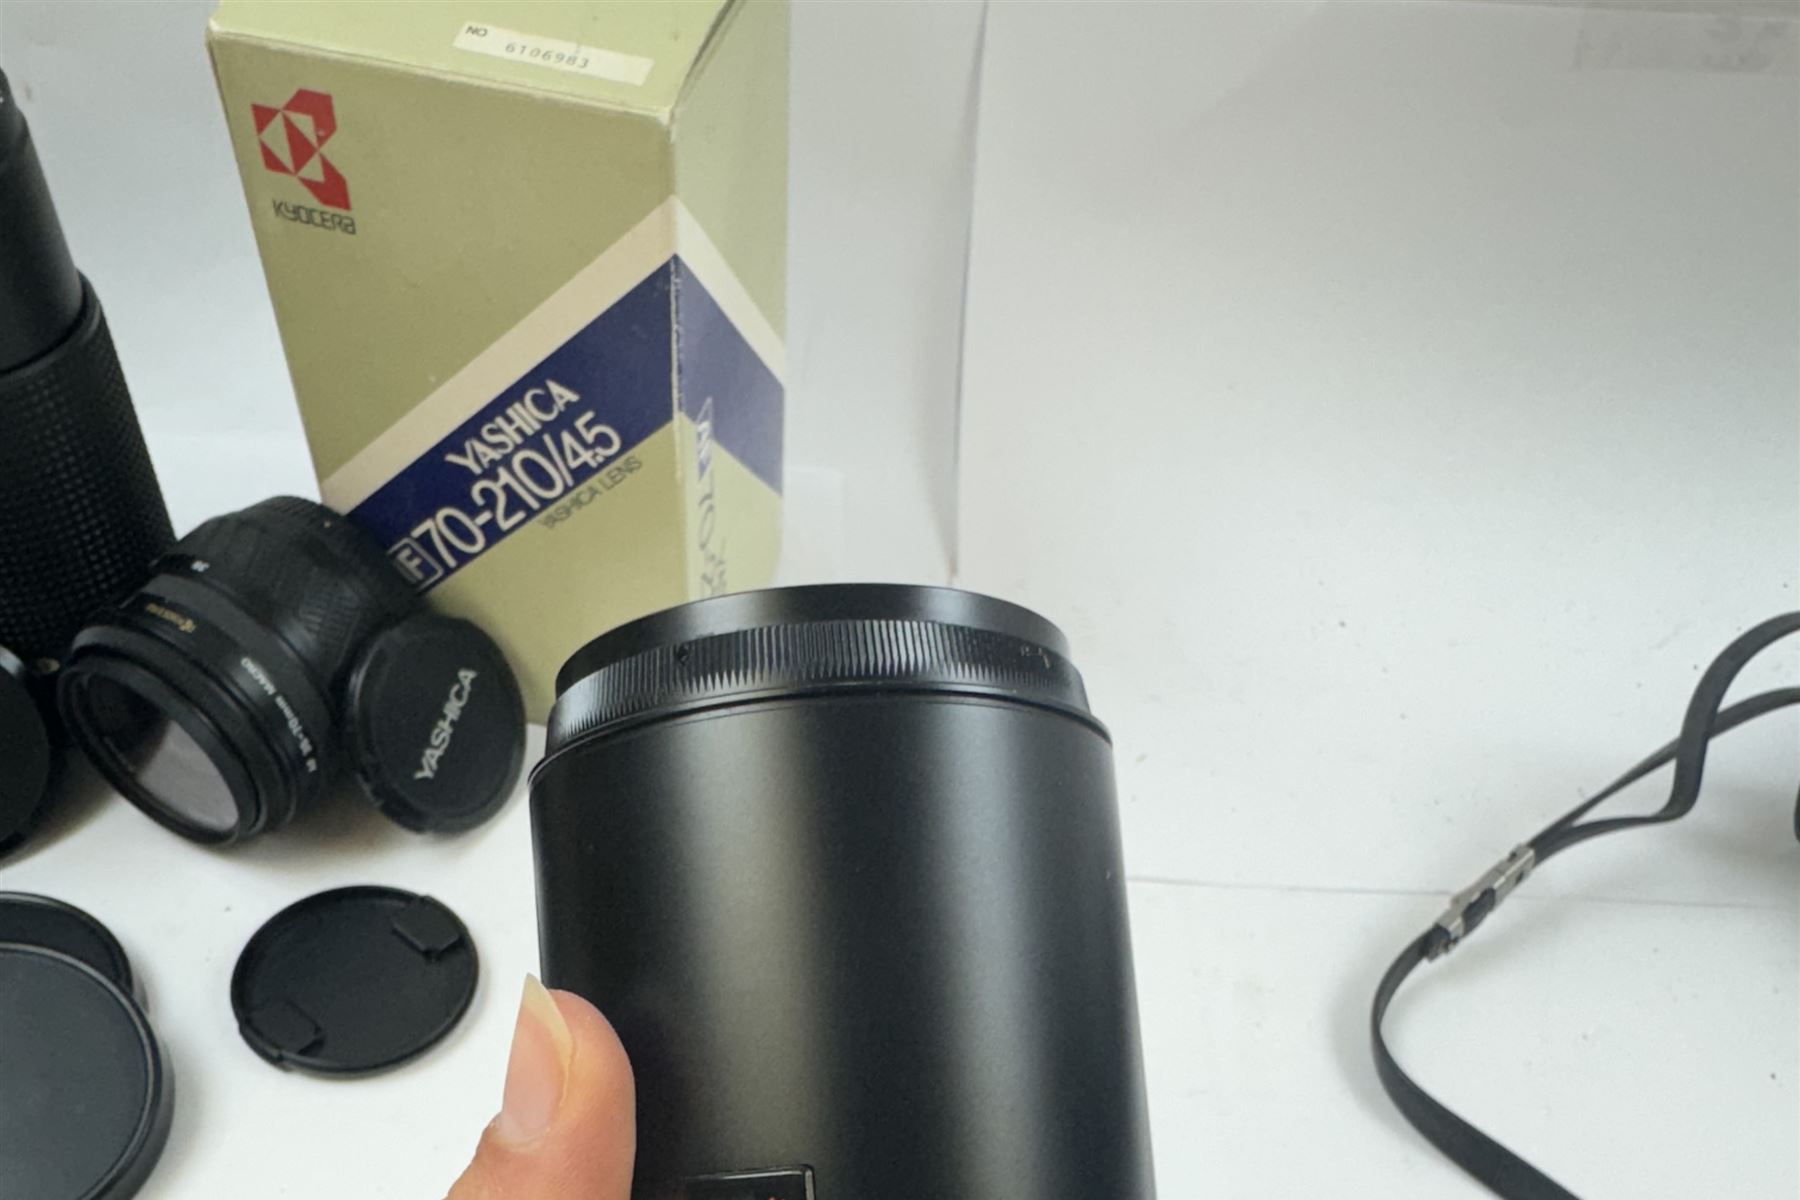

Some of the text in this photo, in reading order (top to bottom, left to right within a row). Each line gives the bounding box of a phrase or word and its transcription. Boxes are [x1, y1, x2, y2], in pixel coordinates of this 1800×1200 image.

[505, 42, 589, 69] 6106983
[271, 198, 356, 235] KYOCERA
[445, 379, 581, 476] YASHICA
[539, 456, 642, 529] YASHICA LENS
[414, 667, 479, 783] YASHICA
